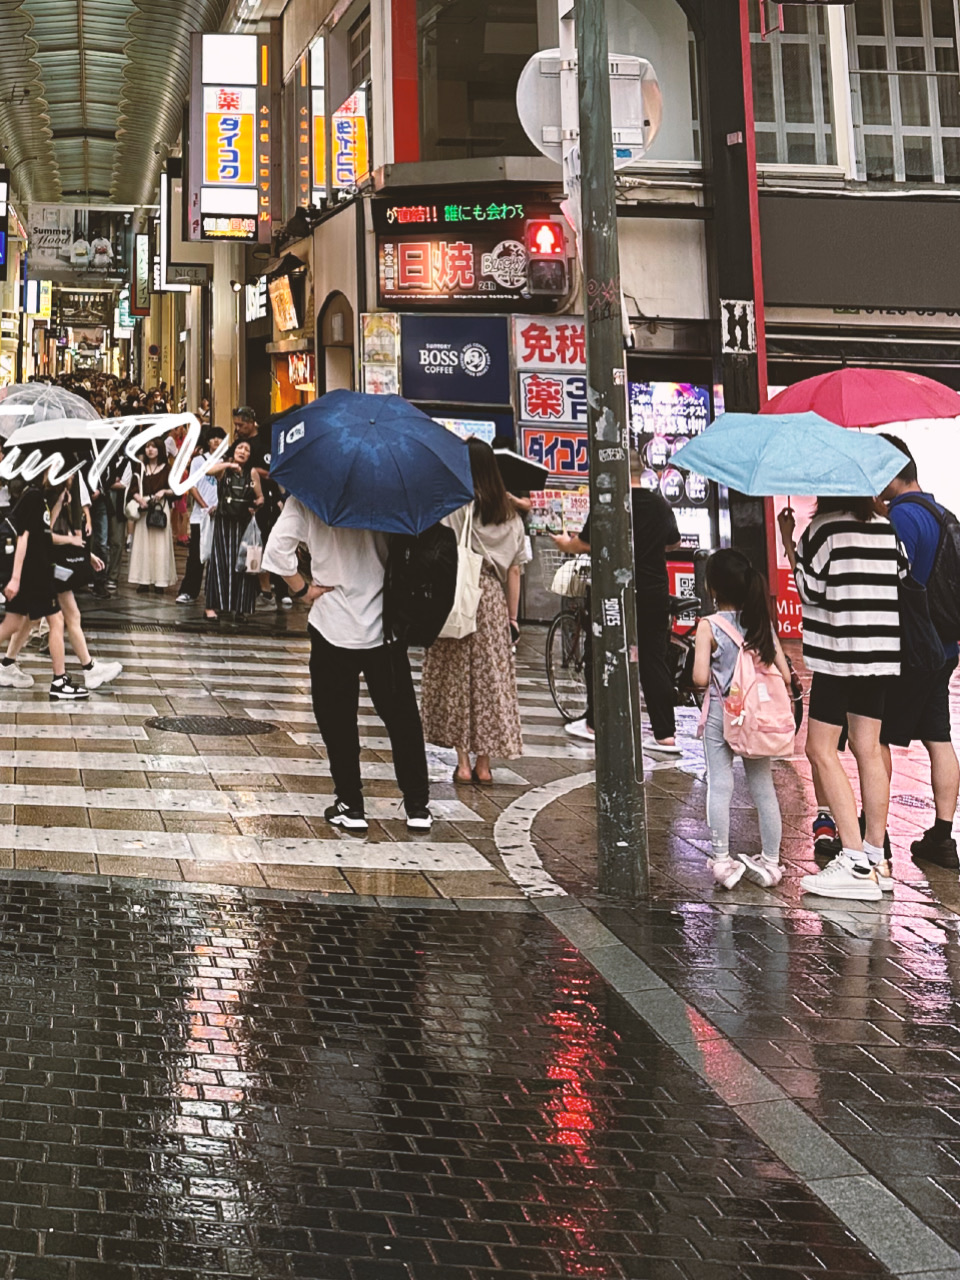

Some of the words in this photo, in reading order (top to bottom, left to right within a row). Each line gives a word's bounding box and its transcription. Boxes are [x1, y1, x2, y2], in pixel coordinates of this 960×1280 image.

[218, 88, 241, 111] 薬
[218, 116, 241, 180] ダイコク
[33, 227, 71, 235] Summer
[174, 267, 200, 278] NICE
[397, 241, 474, 291] 日焼
[478, 281, 496, 290] 24h
[521, 322, 586, 364] 免税
[419, 349, 458, 365] BOSS
[424, 366, 453, 374] COFFEE
[525, 374, 562, 418] 薬
[529, 434, 589, 472] ダイコク
